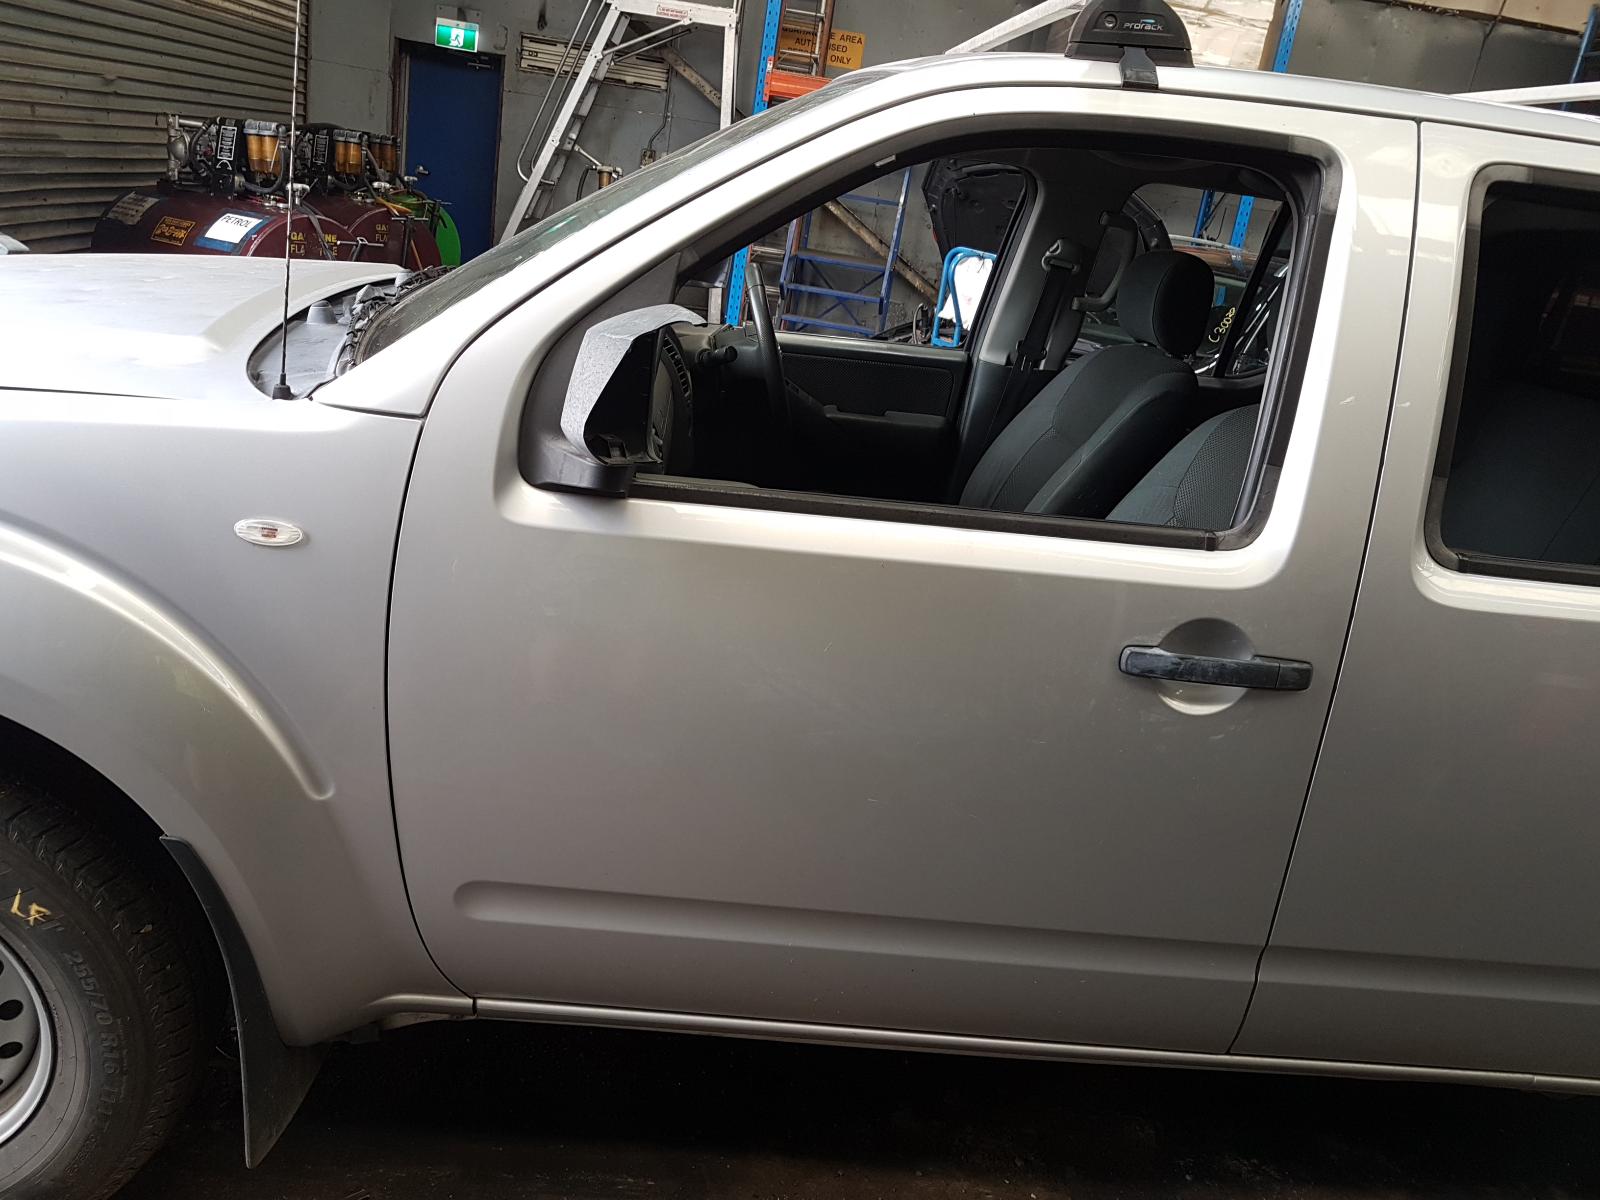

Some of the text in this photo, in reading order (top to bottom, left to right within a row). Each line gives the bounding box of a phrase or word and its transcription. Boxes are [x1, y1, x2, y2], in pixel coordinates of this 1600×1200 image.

[840, 33, 863, 45] AREA
[830, 54, 852, 65] ONLY
[221, 215, 252, 228] PETROL
